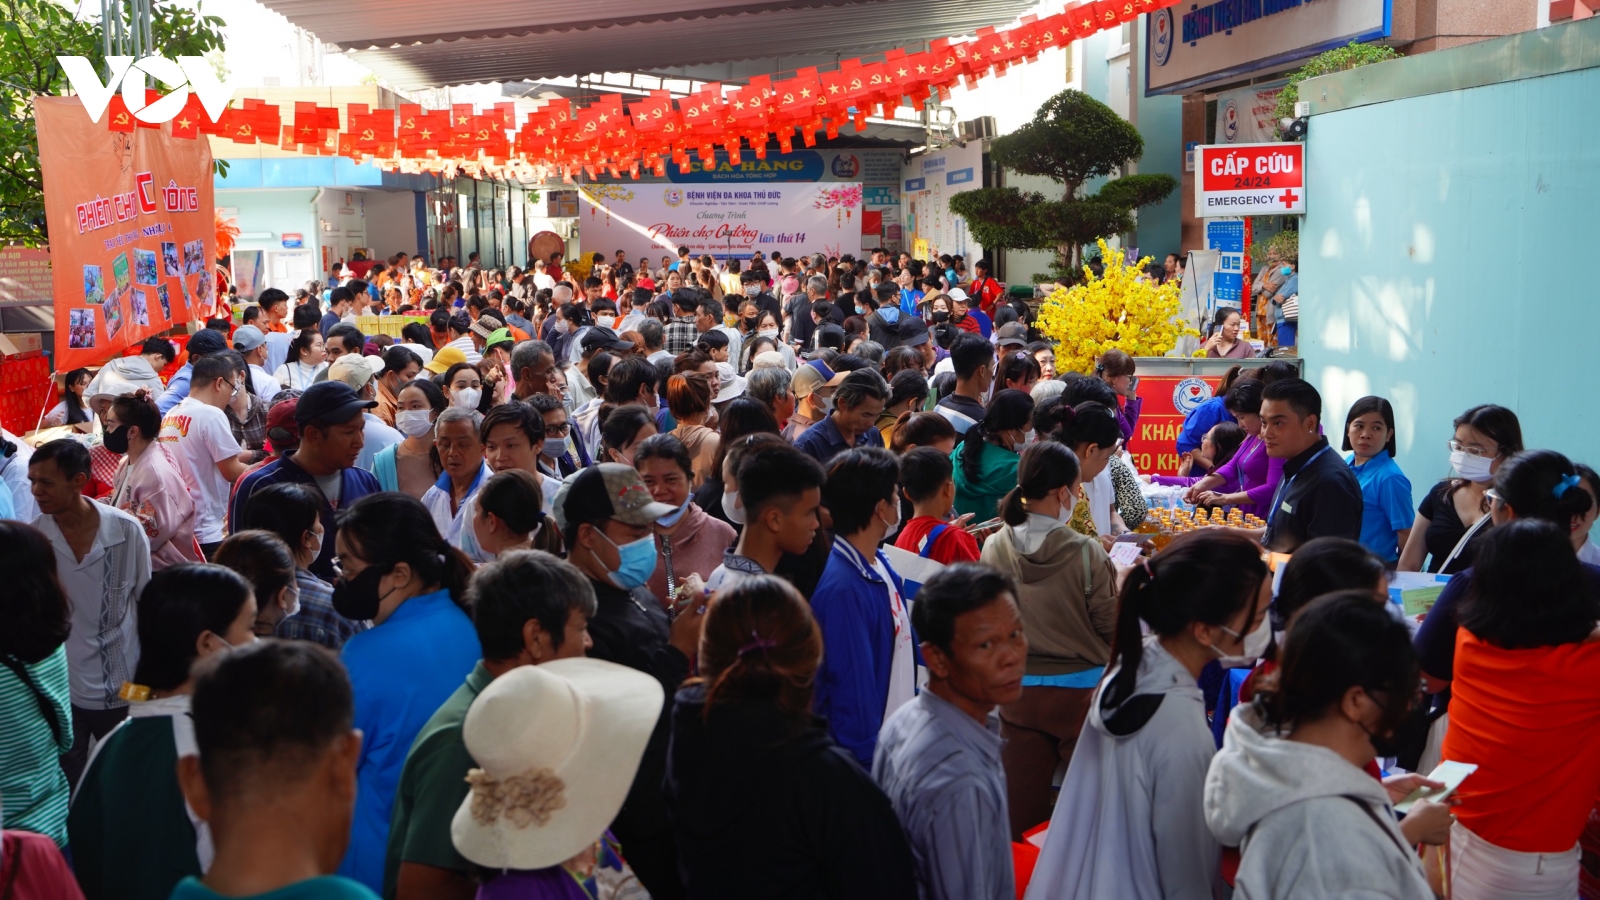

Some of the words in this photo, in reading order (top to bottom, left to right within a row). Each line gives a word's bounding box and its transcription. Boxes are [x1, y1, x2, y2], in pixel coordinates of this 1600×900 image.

[1182, 4, 1213, 47] BỆNH
[740, 158, 805, 171] HÀNG
[1211, 151, 1249, 176] CẤP
[1255, 151, 1294, 174] CỨU
[745, 171, 763, 179] TỔNG
[763, 171, 778, 179] HỢP
[1234, 176, 1271, 188] 24/24
[686, 190, 705, 201] BỆNH
[706, 190, 722, 201] VIỆN
[734, 191, 752, 199] KHOA
[753, 189, 767, 199] THỦ
[767, 190, 781, 199] ĐỨC
[1207, 195, 1275, 206] EMERGENCY
[648, 222, 690, 239] Phiên
[692, 224, 714, 240] chợ
[795, 232, 806, 244] 14
